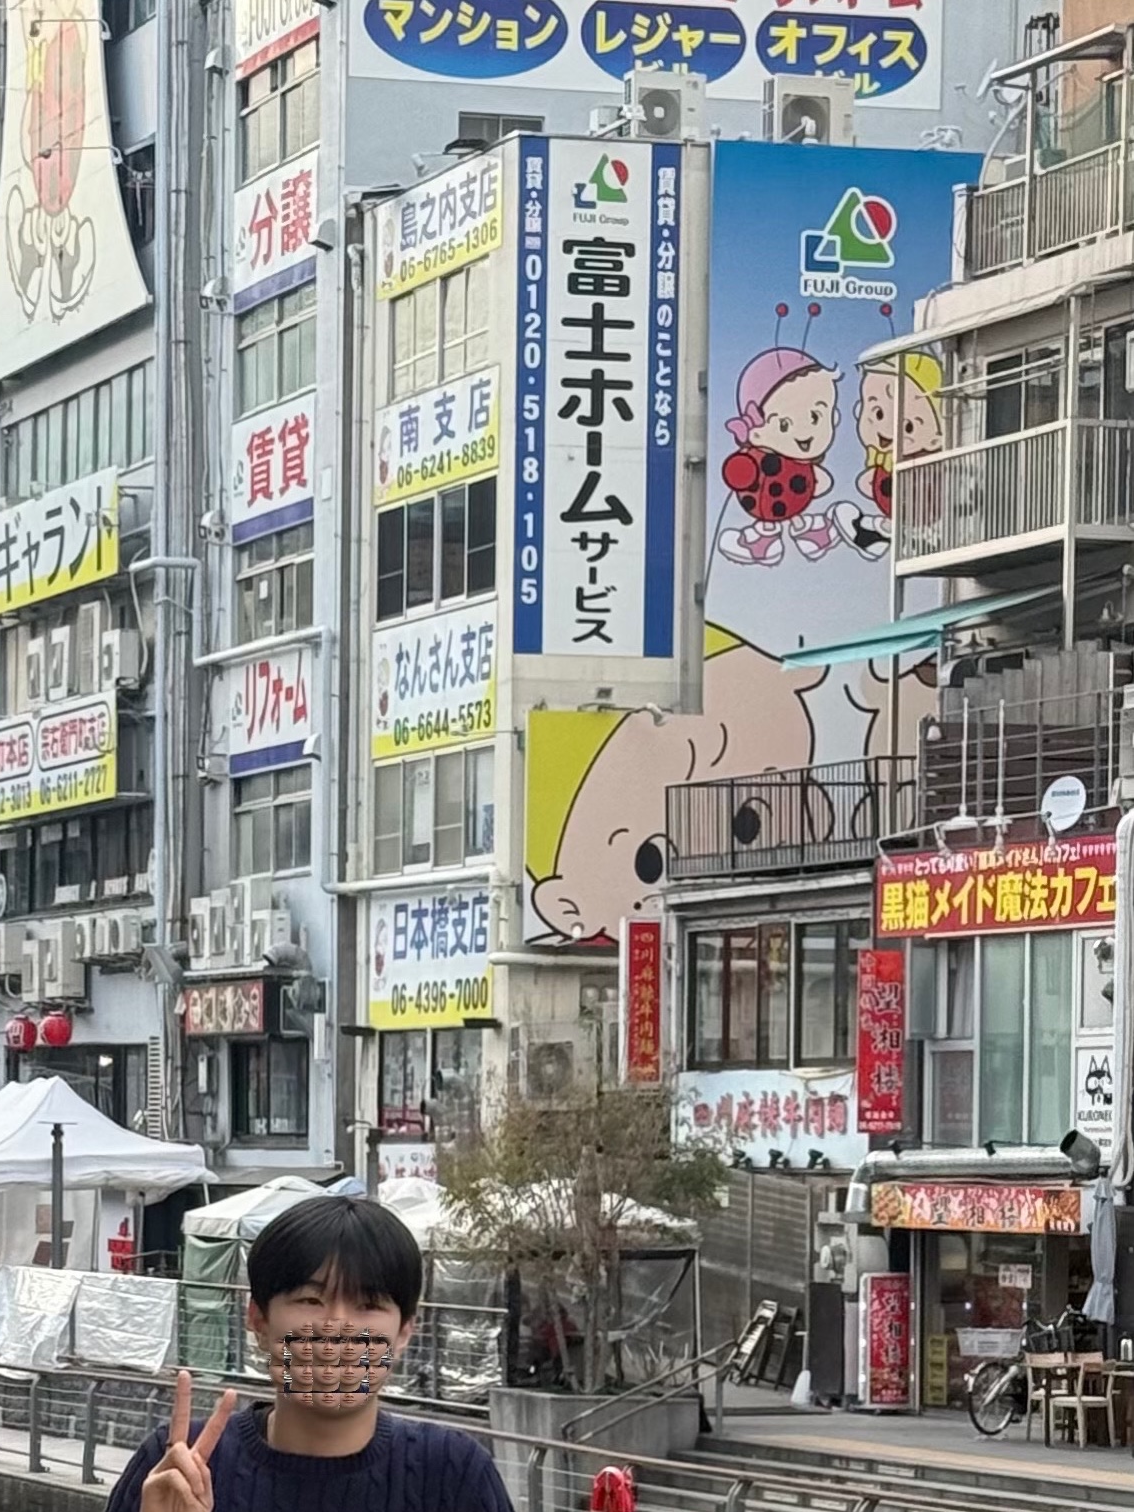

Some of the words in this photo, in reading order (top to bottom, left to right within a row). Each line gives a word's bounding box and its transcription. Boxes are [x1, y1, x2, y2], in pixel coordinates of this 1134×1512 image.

[377, 0, 560, 51] マンション
[595, 10, 741, 57] レジャー
[767, 18, 920, 71] オフィス
[249, 169, 313, 270] 分譲
[399, 160, 499, 252] 島之内支店
[572, 212, 597, 224] FUJI
[399, 216, 498, 283] 06-6765-1306
[803, 278, 841, 294] FUJI
[845, 280, 894, 297] Group
[398, 377, 492, 459] 南支店
[557, 236, 636, 644] 富士ホームサービス
[246, 412, 310, 508] 賃貸
[396, 433, 496, 490] 06-6241-8839
[394, 621, 495, 701] なんさん支店
[245, 650, 308, 744] リフォーム
[393, 698, 492, 747] 06-6644-5573
[392, 890, 490, 961] 日本橋支店
[880, 866, 1116, 932] 黒猫メイド魔法カフェ
[391, 975, 489, 1017] 06-4396-7000
